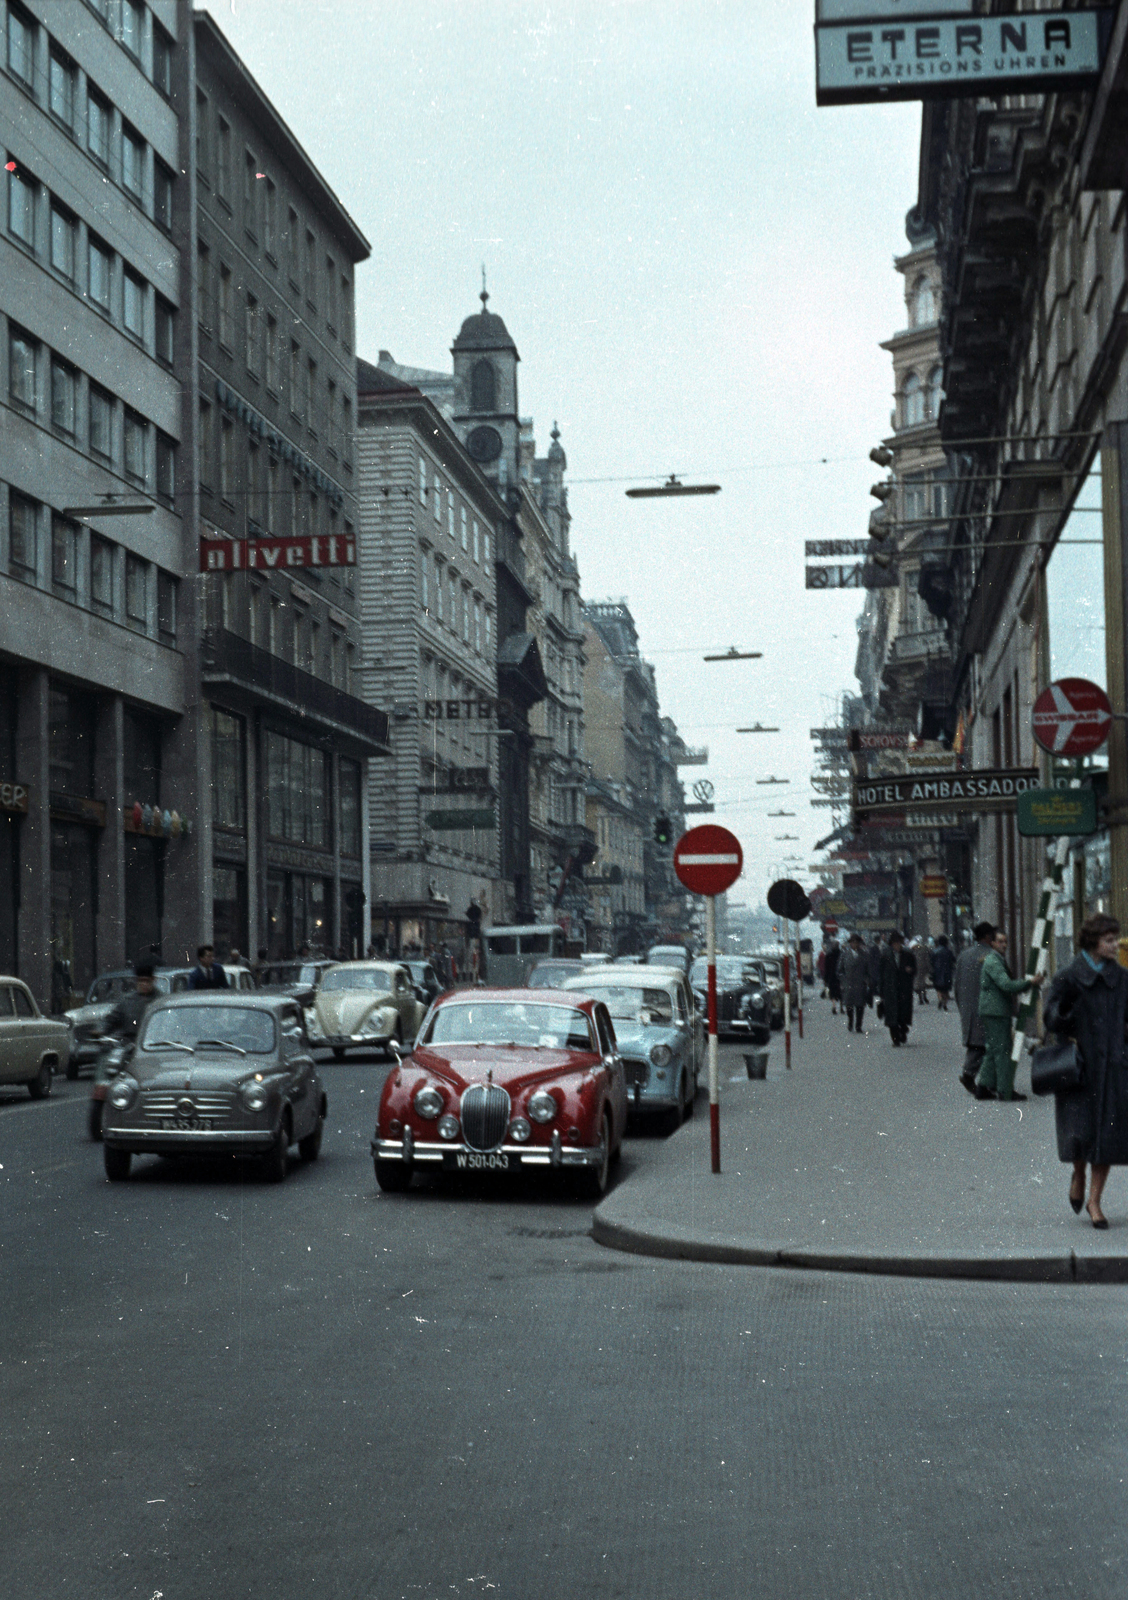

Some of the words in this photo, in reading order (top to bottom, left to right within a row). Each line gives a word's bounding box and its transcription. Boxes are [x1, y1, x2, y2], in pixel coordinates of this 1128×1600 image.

[847, 19, 1071, 62] ETERNA
[995, 55, 1065, 70] UHREN
[858, 783, 904, 804] HOTEL
[456, 1153, 467, 1168] W
